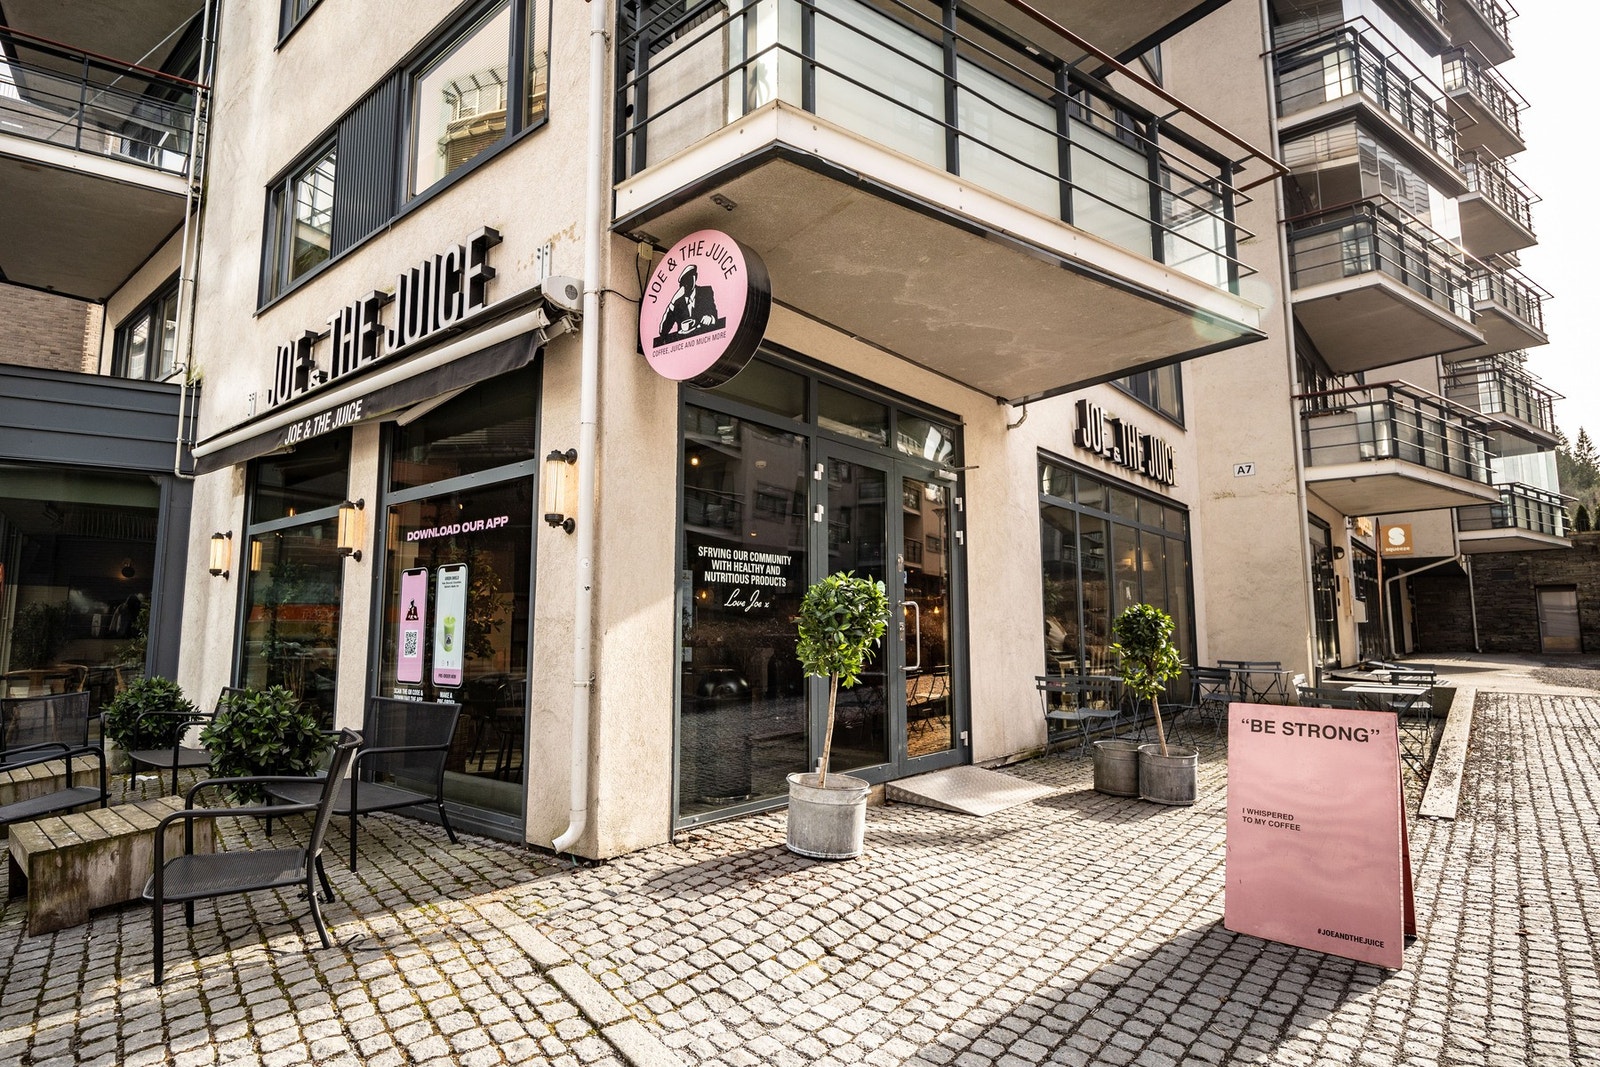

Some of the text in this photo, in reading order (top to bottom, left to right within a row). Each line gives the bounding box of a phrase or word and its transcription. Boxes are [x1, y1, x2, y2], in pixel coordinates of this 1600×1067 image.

[648, 240, 738, 304] JOE & THE JUICE
[267, 226, 500, 407] JOE & THE JUICE
[670, 342, 684, 353] JUICE
[684, 340, 696, 349] AND
[696, 336, 711, 346] MUCH
[712, 331, 727, 341] MORE
[284, 399, 363, 445] JOE & THE JUICE
[1077, 399, 1110, 458] JOE
[1113, 446, 1121, 462] &
[1116, 418, 1146, 473] THE
[1237, 464, 1252, 475] A7
[407, 515, 509, 541] DOWNLOAD OUR APP
[711, 559, 781, 576] WITH HEALTHY AND
[733, 549, 749, 561] OUR
[750, 552, 792, 565] COMMUNITY
[704, 571, 787, 587] NUTRITIOUS PRODUCTS
[724, 588, 746, 606] Love
[744, 589, 762, 612] Joe
[1242, 816, 1301, 832] TO MY COFFEE
[1246, 808, 1294, 821] WHISPERED
[1317, 928, 1385, 949] #JOEANDTHEJUICE
